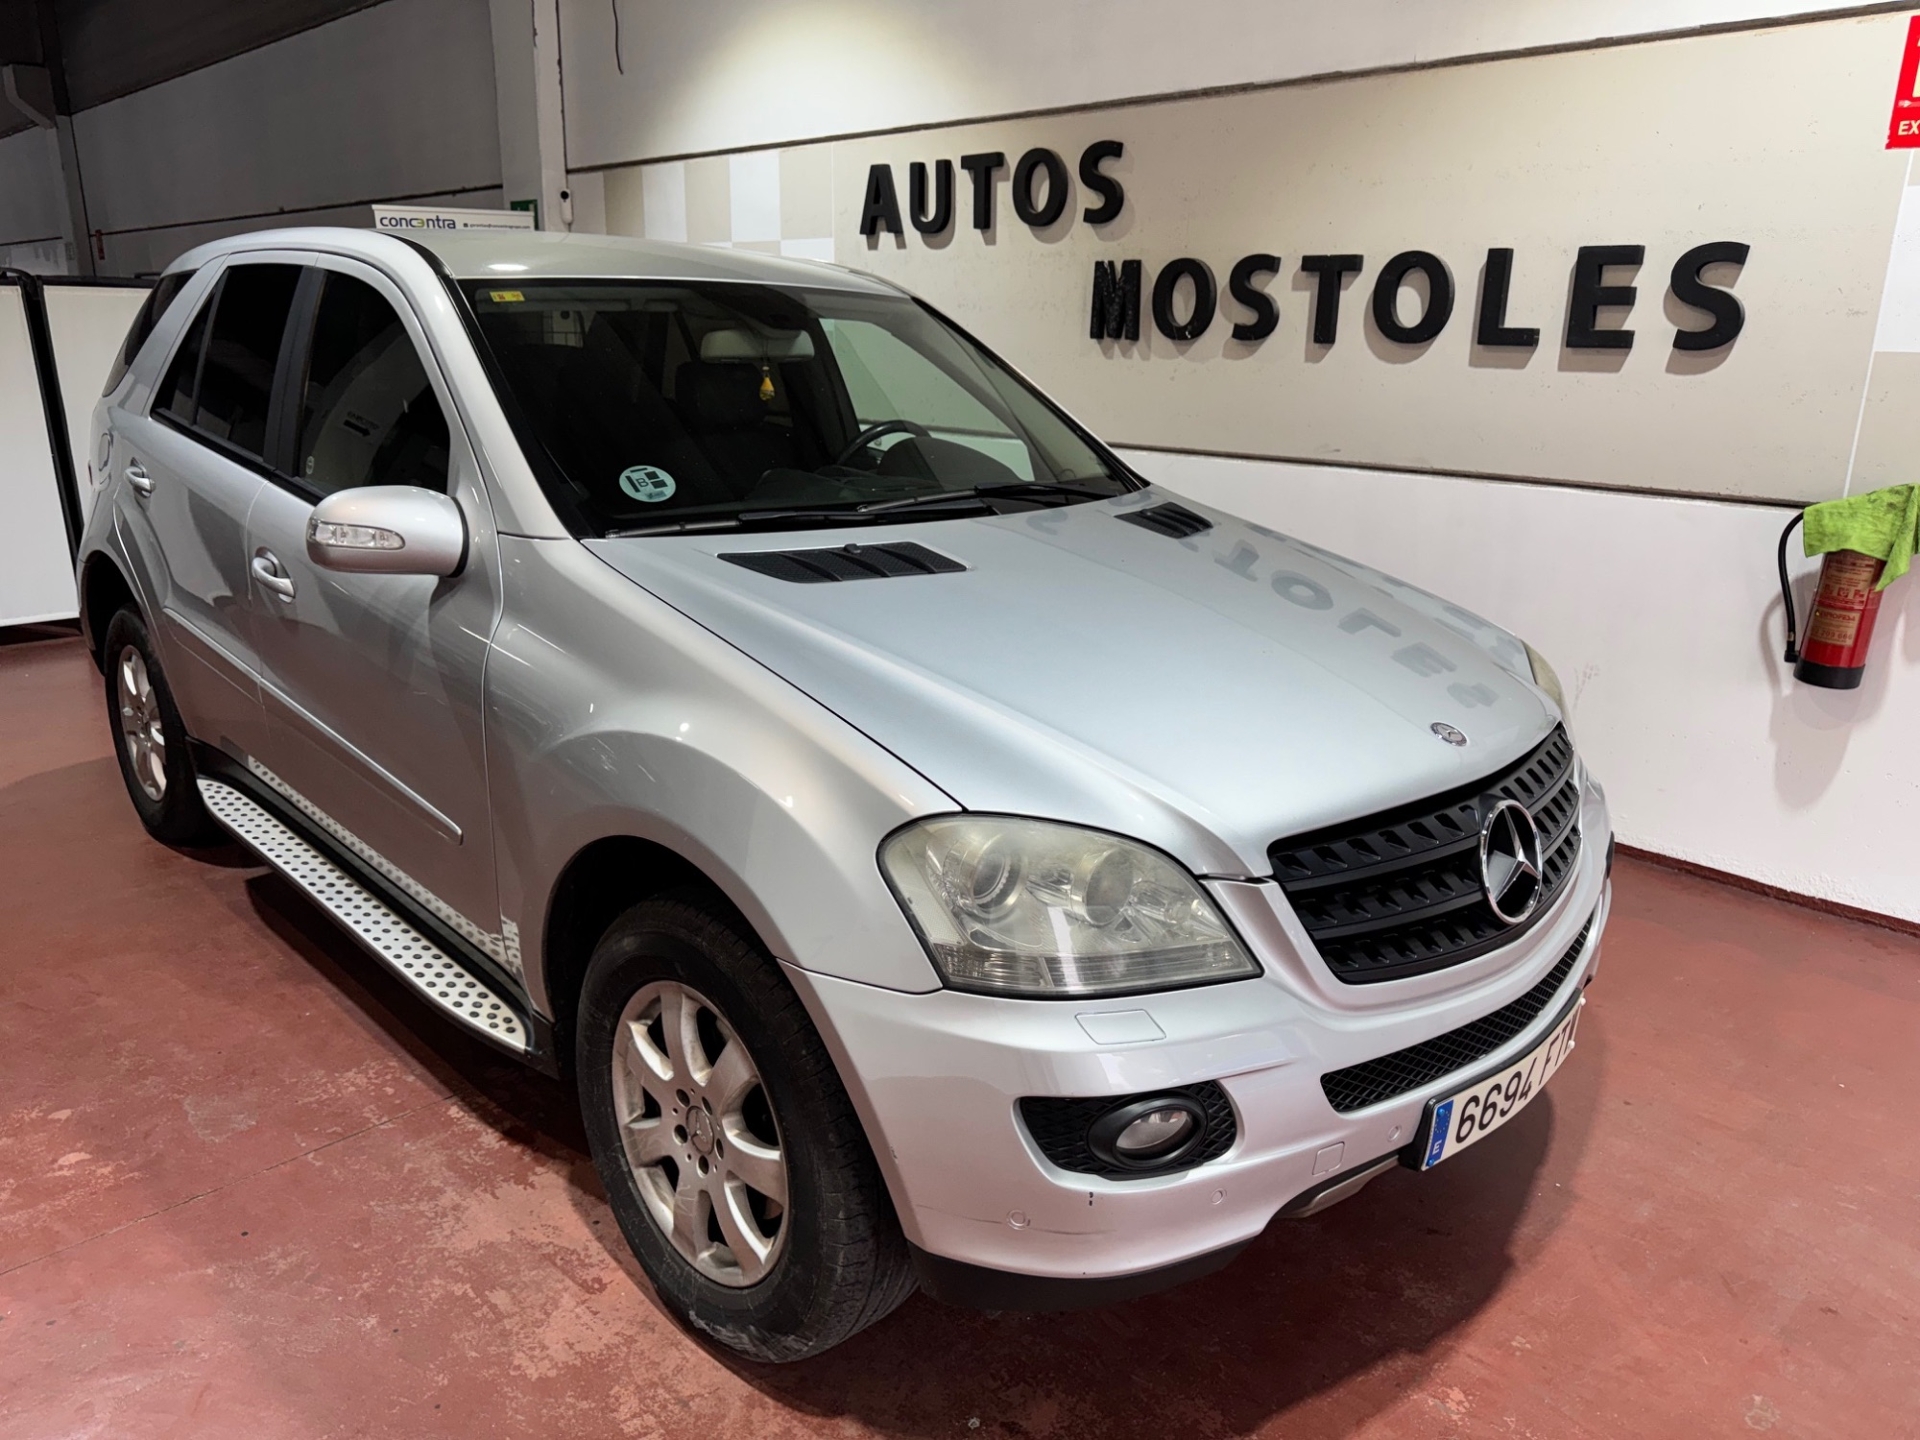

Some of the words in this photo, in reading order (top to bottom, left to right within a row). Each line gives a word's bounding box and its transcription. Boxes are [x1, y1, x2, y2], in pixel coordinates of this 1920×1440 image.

[859, 140, 1125, 236] AUTOS
[379, 215, 456, 229] concentra
[1090, 241, 1751, 351] MOSTOLES
[635, 477, 649, 488] B
[1455, 1056, 1538, 1144] 6694
[1432, 1139, 1443, 1156] E
